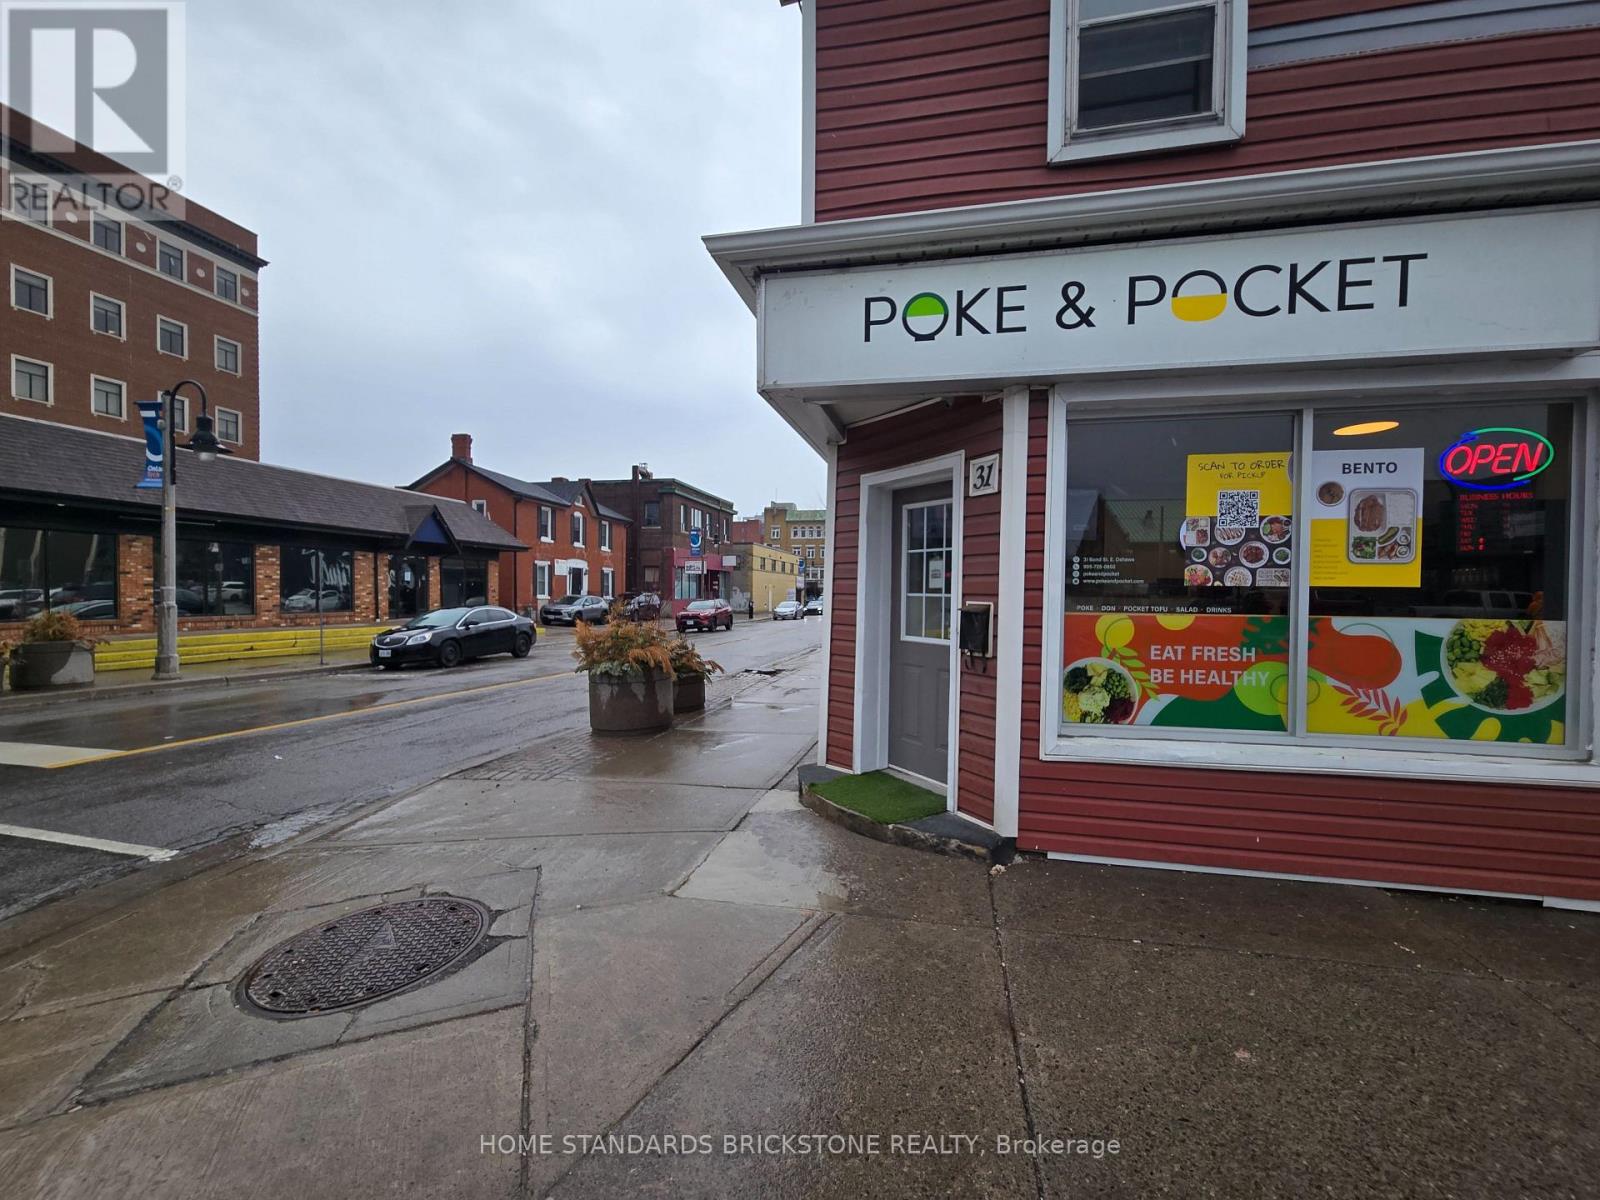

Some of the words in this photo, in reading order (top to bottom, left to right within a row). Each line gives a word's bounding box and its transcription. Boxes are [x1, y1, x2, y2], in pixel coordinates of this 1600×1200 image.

[864, 284, 1028, 343] POKE
[1055, 280, 1096, 331] &
[1127, 252, 1429, 326] POCKET
[1198, 460, 1226, 472] SCAN
[1230, 461, 1246, 471] TO
[1250, 458, 1286, 471] ORDER
[1341, 461, 1398, 475] BENTO
[1445, 442, 1544, 475] OPEN
[972, 462, 994, 490] 31
[1150, 645, 1186, 661] EAT
[1191, 646, 1256, 662] FRESH
[1150, 668, 1174, 684] BE
[1180, 669, 1270, 687] HEALTHY
